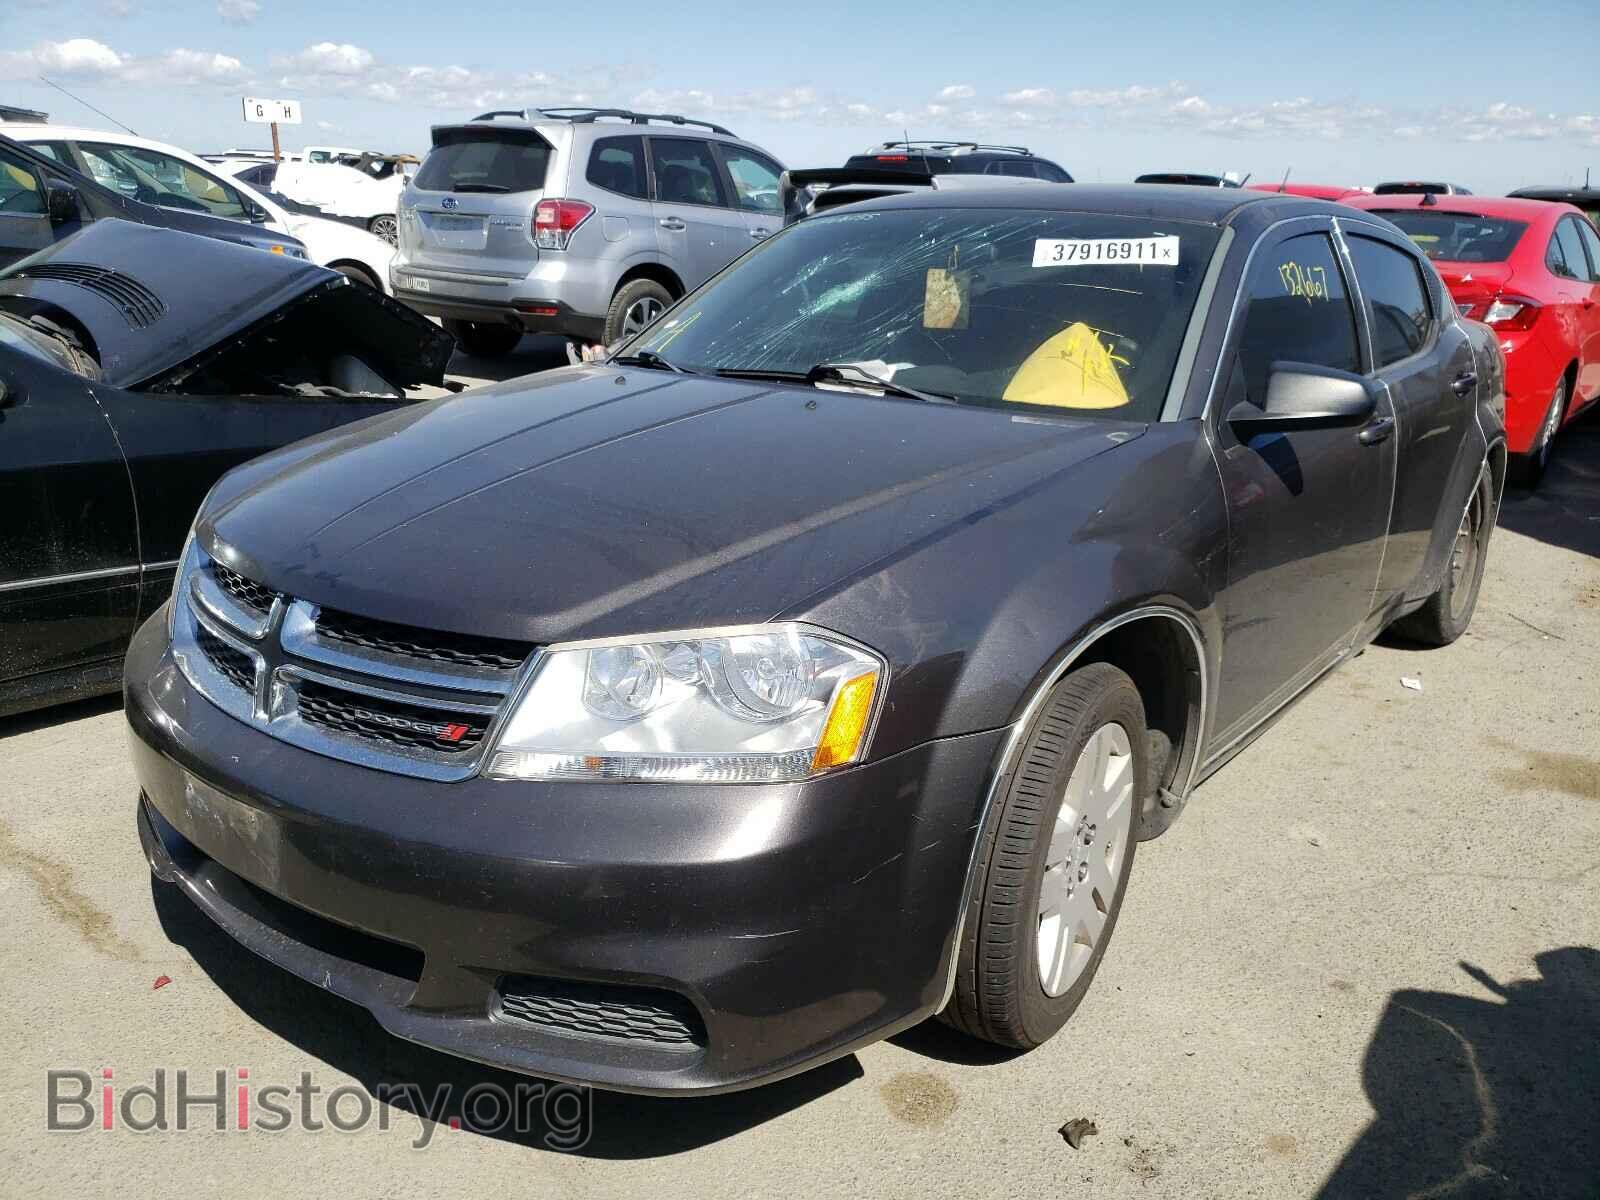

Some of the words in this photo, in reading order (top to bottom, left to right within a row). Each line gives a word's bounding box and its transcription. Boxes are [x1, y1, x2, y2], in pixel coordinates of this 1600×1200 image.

[256, 104, 264, 117] G
[283, 106, 292, 119] H
[1052, 242, 1157, 262] 37916911
[355, 708, 452, 740] DODGE
